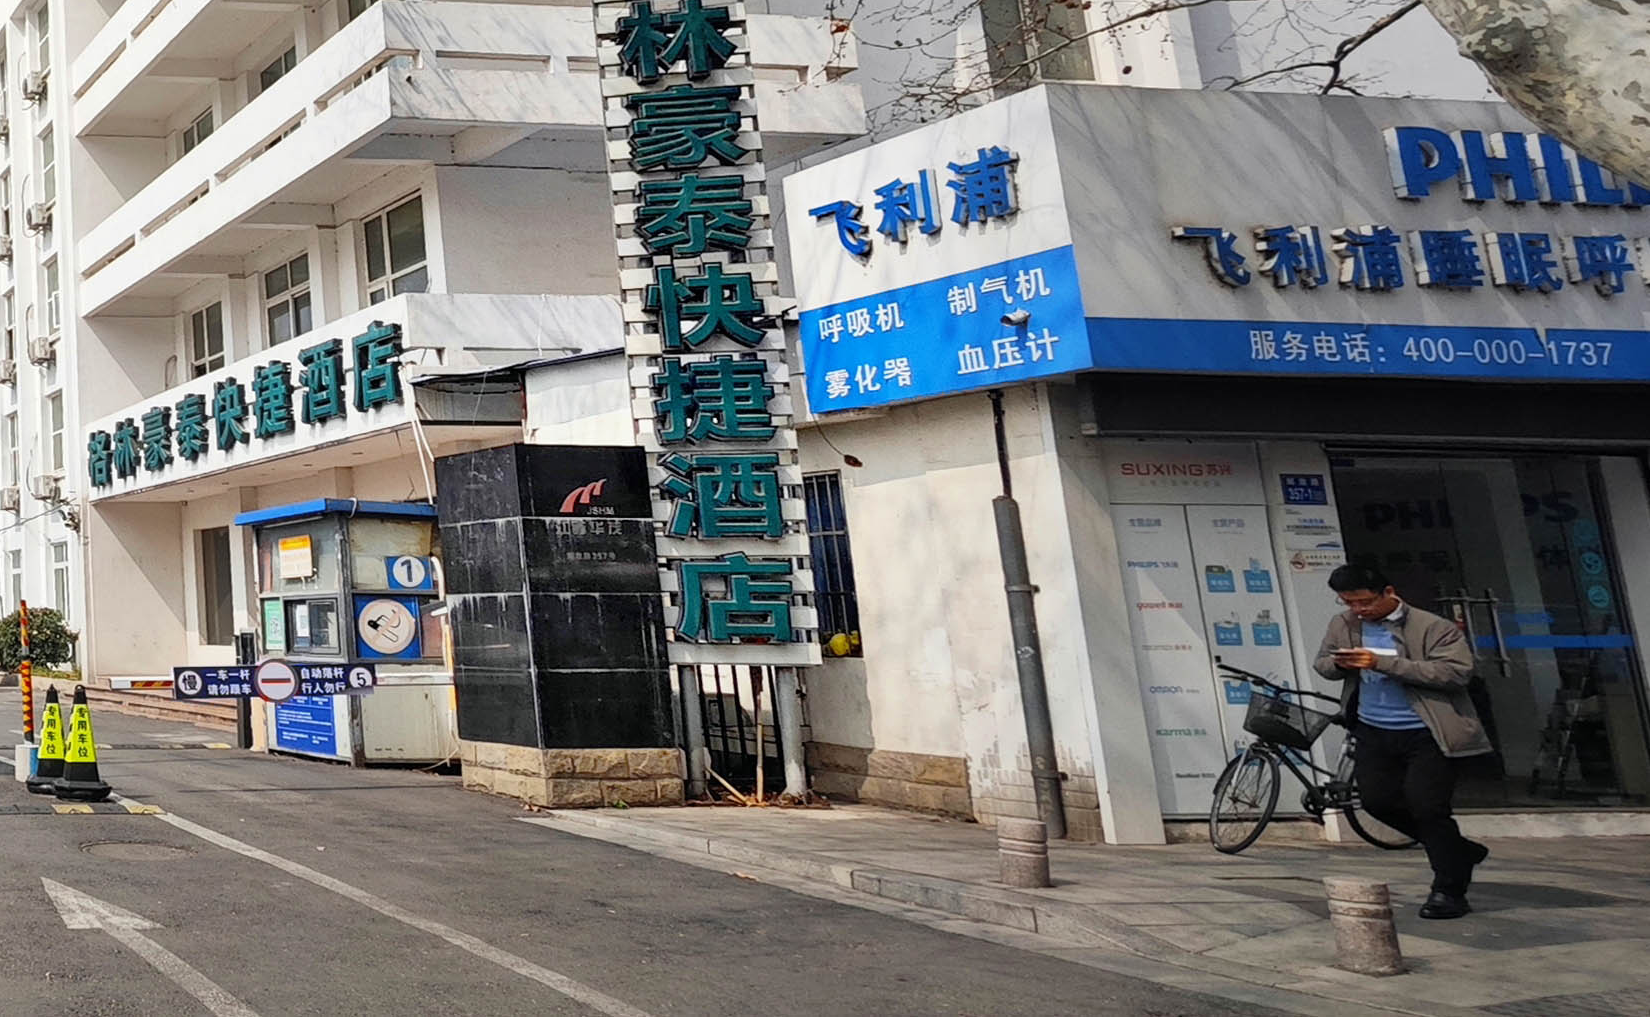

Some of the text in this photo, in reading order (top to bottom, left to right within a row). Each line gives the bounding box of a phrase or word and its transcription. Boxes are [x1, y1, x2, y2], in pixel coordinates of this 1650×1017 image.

[1385, 126, 1650, 205] PHIL
[809, 146, 1019, 257] 飞利浦
[1171, 224, 1650, 294] 飞利浦睡眠呼
[819, 267, 1051, 343] 呼吸机 制气机
[824, 328, 1059, 399] 雾化器 血压计
[88, 320, 403, 488] 格林豪泰快捷酒店
[401, 559, 414, 583] 1
[205, 669, 251, 681] 一车一杆
[207, 683, 252, 695] 请勿跟车
[300, 667, 345, 680] 自动落杆
[301, 682, 346, 694] 行人勿行
[356, 672, 366, 687] 5
[46, 705, 57, 755] 专用车位
[77, 706, 89, 758] 专用车位
